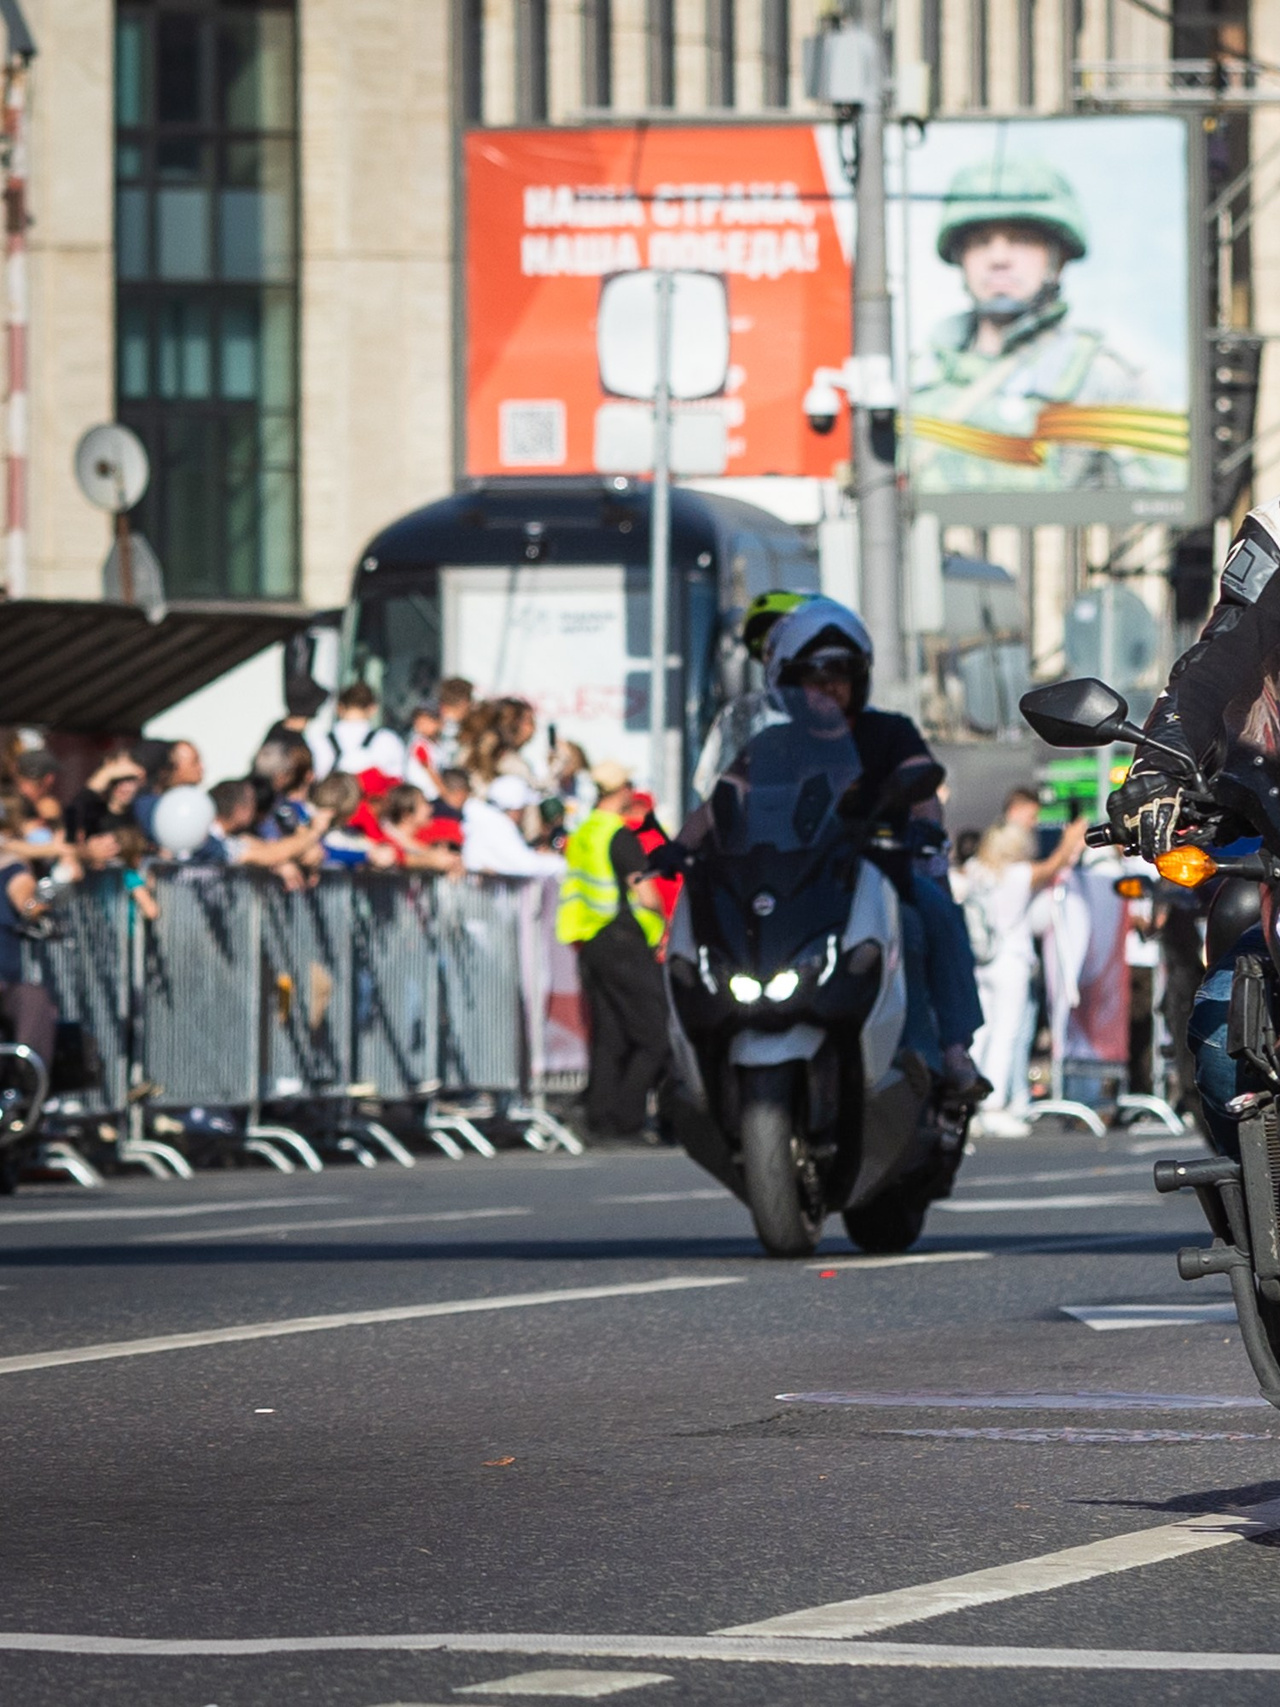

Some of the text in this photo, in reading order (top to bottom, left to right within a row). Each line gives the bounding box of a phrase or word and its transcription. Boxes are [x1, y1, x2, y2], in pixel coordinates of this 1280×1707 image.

[523, 182, 816, 228] НАША СТРАНА,
[520, 230, 819, 279] НАША ПОБЕДА!
